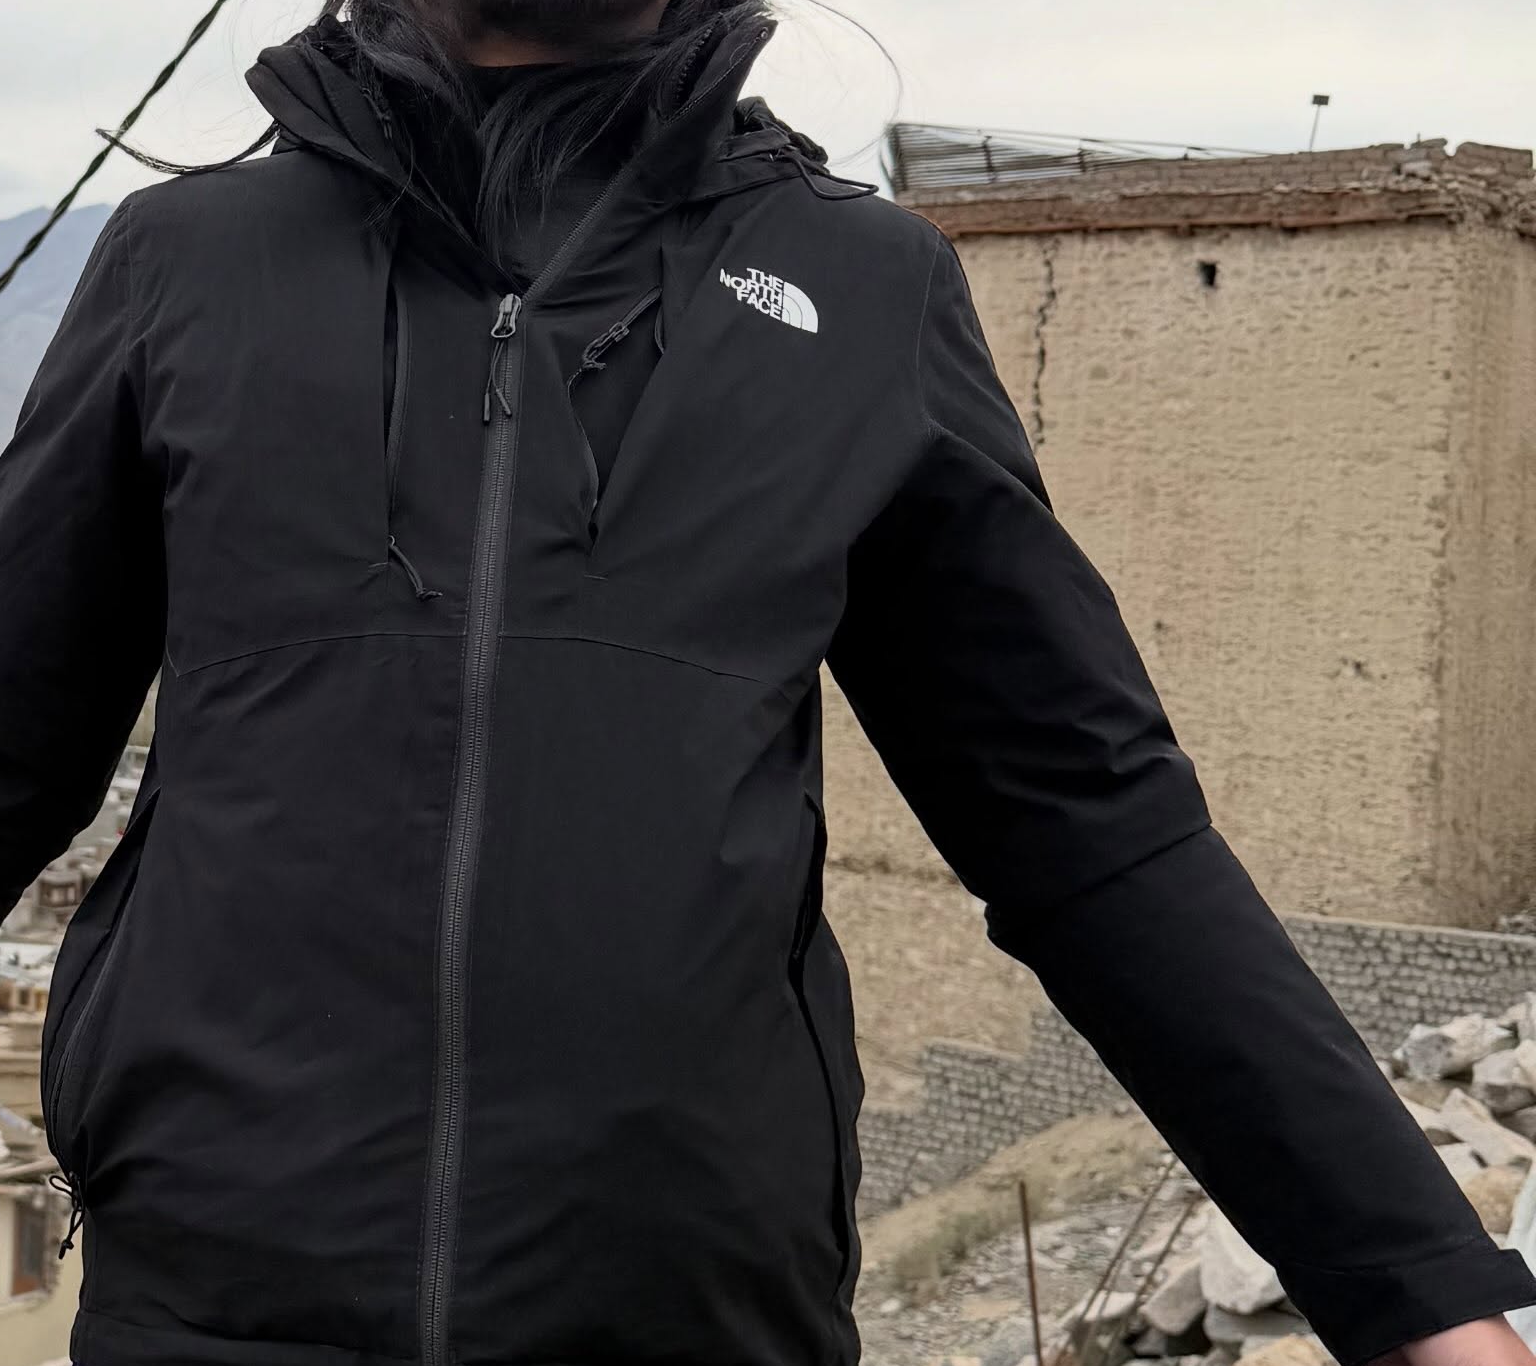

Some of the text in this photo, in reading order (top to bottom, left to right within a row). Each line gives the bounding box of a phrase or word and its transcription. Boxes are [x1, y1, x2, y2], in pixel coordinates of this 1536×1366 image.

[719, 268, 783, 307] NORTH
[746, 267, 784, 291] THE
[736, 288, 782, 321] FACE
